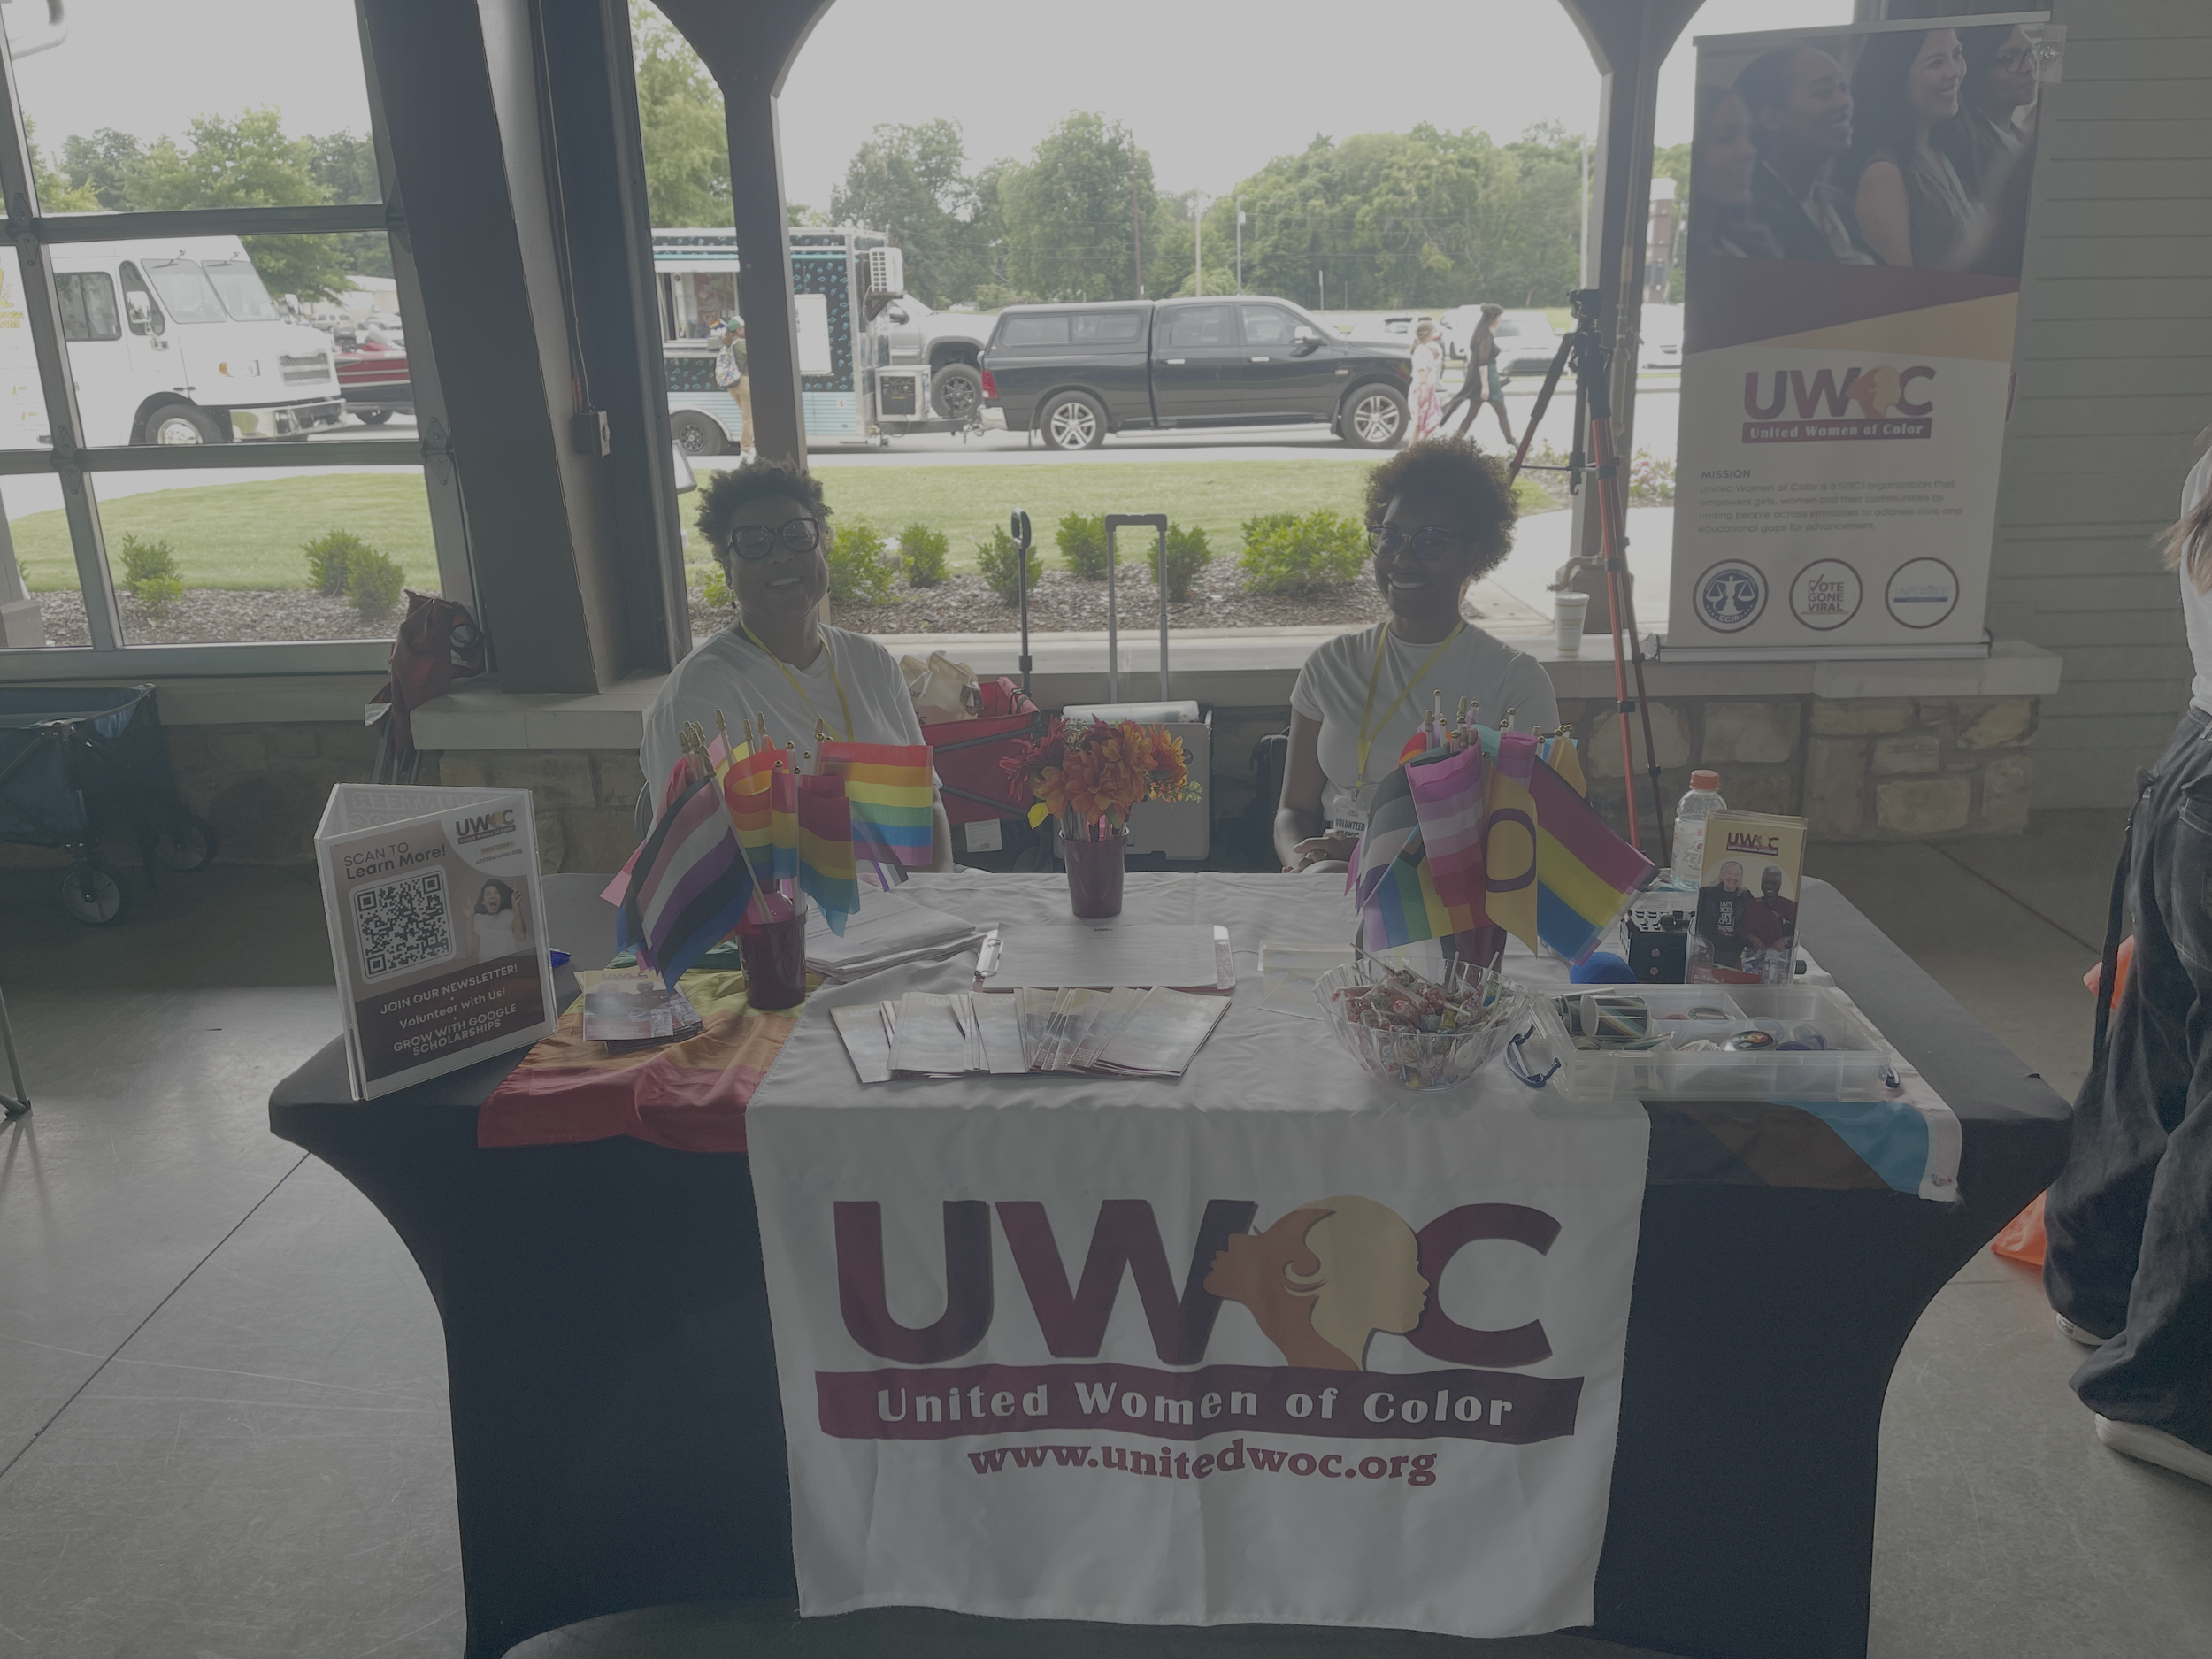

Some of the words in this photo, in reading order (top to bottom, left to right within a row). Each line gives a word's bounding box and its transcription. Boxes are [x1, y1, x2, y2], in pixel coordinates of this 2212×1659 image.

[1750, 426, 1798, 438] United
[1805, 426, 1857, 437] Women
[1863, 425, 1877, 435] of
[1883, 423, 1923, 434] Color
[1701, 469, 1751, 479] MISSION
[1736, 484, 1774, 493] Women
[1867, 481, 1932, 491] organization
[1699, 498, 1751, 507] empowers
[1932, 494, 1946, 503] by
[1699, 511, 1732, 520] uniting
[1735, 511, 1770, 520] people
[1698, 524, 1758, 533] educational
[1761, 524, 1787, 534] gaps
[1790, 523, 1803, 532] for
[1805, 522, 1876, 531] advancement.
[1808, 593, 1844, 602] GONE
[1808, 603, 1843, 611] VIRAL
[1335, 818, 1365, 832] VOLUNTEER
[343, 847, 386, 867] SCAN
[389, 841, 409, 856] TO
[346, 859, 395, 880] Learn
[399, 843, 447, 868] More!
[475, 849, 523, 864] unitedwoc.org
[1681, 851, 1701, 864] ZE
[380, 999, 411, 1014] JOIN
[413, 988, 440, 1003] OUR
[442, 963, 518, 995] NEWSLETTER!
[399, 1003, 458, 1029] Volunteer
[461, 995, 486, 1009] with
[488, 987, 506, 1000] Us!
[393, 1031, 433, 1052] GROW
[434, 1020, 465, 1037] WITH
[468, 1003, 518, 1026] GOOGLE
[412, 1018, 502, 1056] SCHOLARSHIPS
[878, 1384, 1048, 1422] United
[1075, 1381, 1258, 1425] Women
[1286, 1388, 1336, 1421] of
[1363, 1390, 1514, 1426] Color
[969, 1440, 1438, 1486] www.unitedwoc.org
